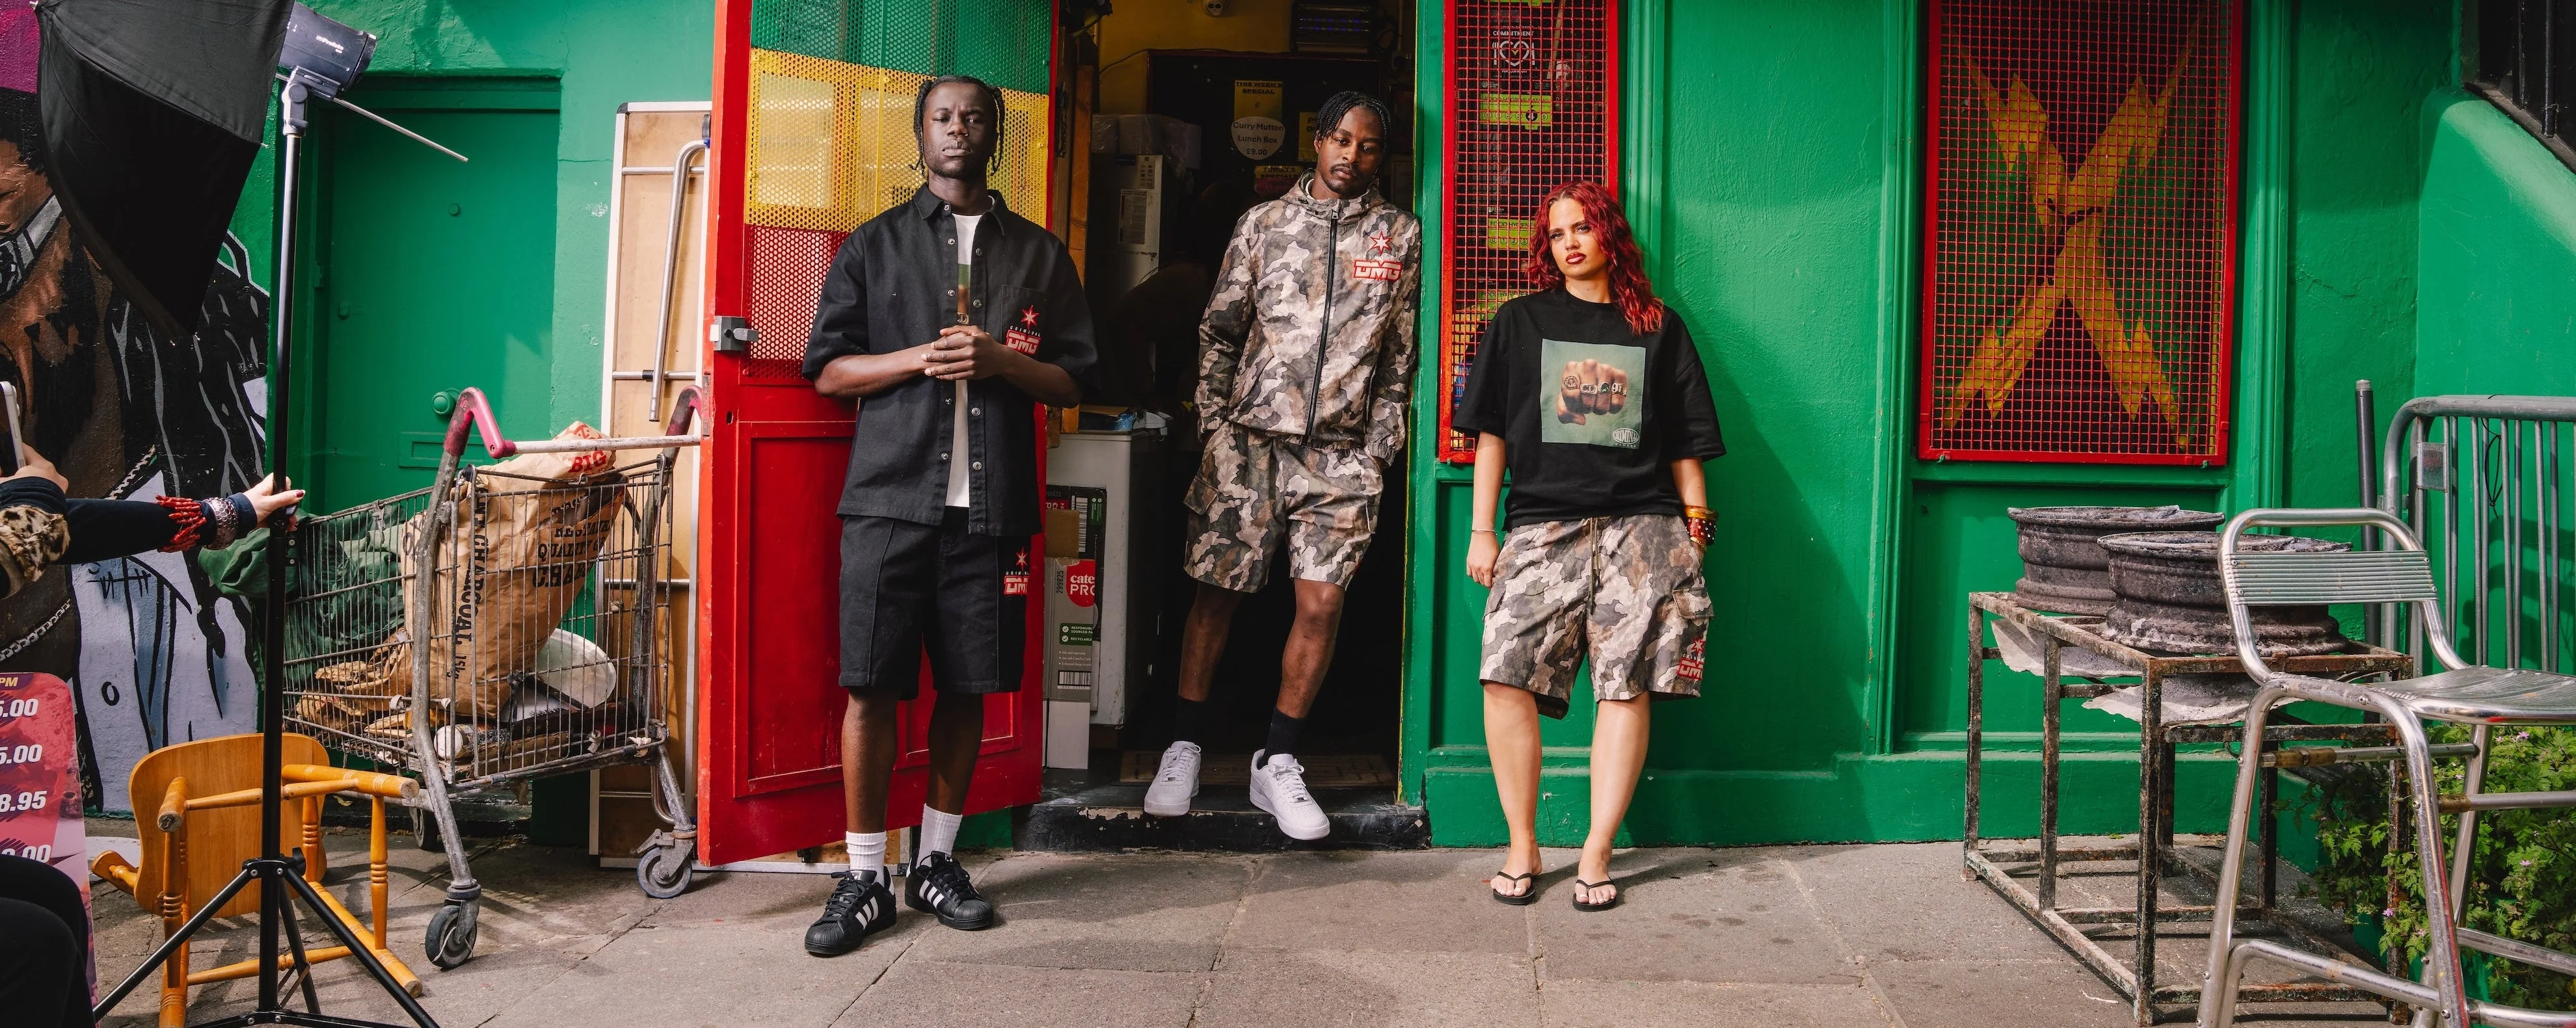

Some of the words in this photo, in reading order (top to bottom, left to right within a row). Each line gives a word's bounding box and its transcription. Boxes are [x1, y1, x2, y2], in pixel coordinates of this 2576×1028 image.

[1233, 122, 1255, 130] Curry
[1005, 576, 1029, 594] DM
[1056, 570, 1064, 594] 299825
[0, 790, 47, 813] 8.95
